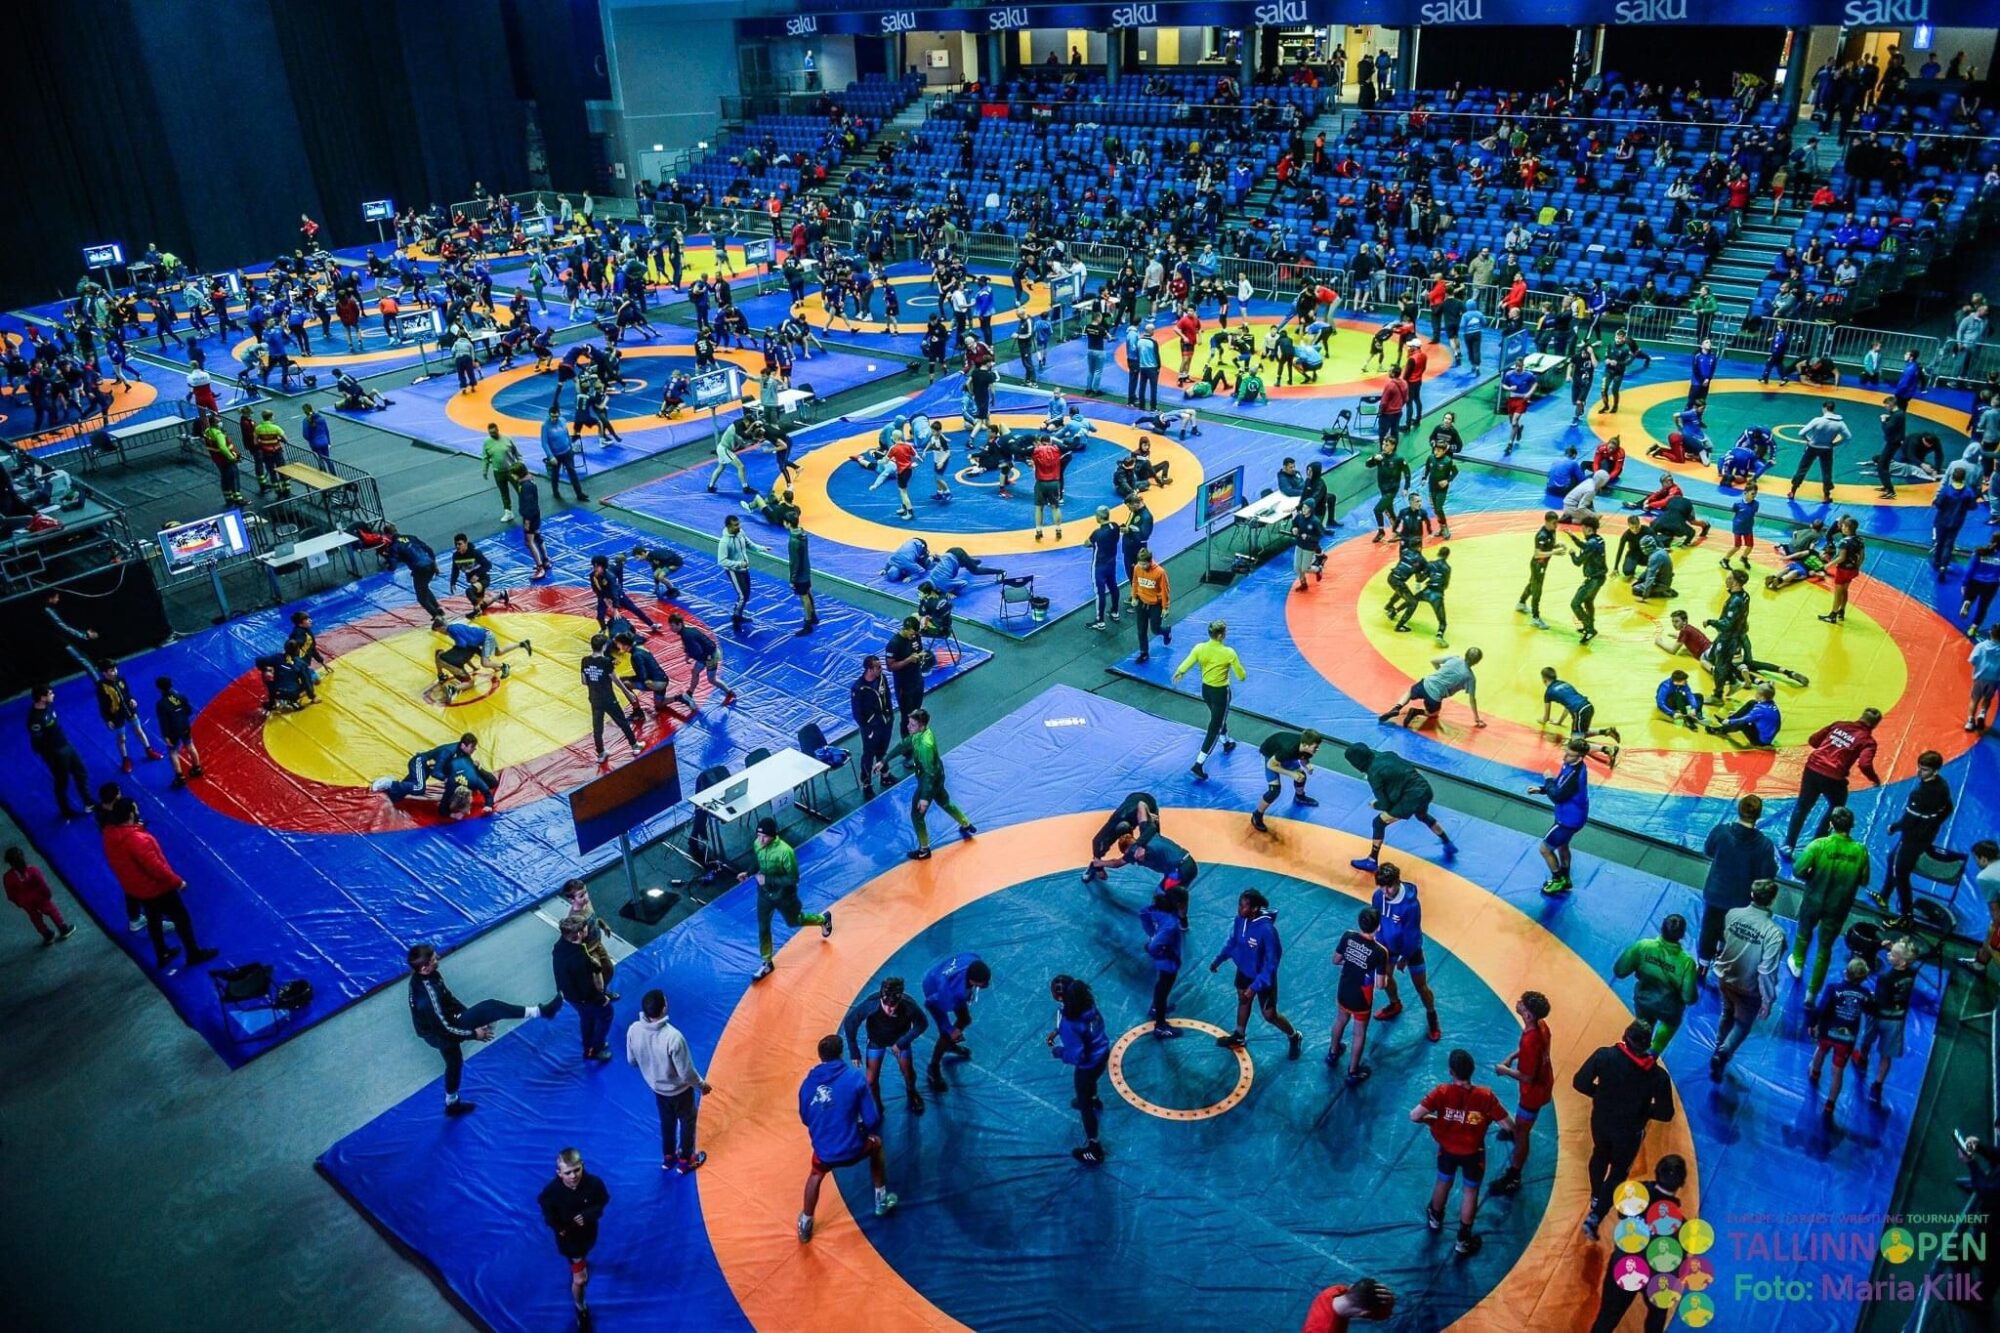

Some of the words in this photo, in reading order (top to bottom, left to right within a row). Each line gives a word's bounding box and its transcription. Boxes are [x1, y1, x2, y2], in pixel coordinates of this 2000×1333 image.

[785, 14, 817, 36] saku
[881, 10, 916, 33] saku
[989, 7, 1029, 31] saku
[1111, 3, 1158, 28] saku
[1254, 0, 1308, 26] saku
[1420, 0, 1483, 25] saku
[1614, 0, 1688, 25] saku
[1843, 0, 1929, 26] saku
[1833, 728, 1855, 743] LATVIA
